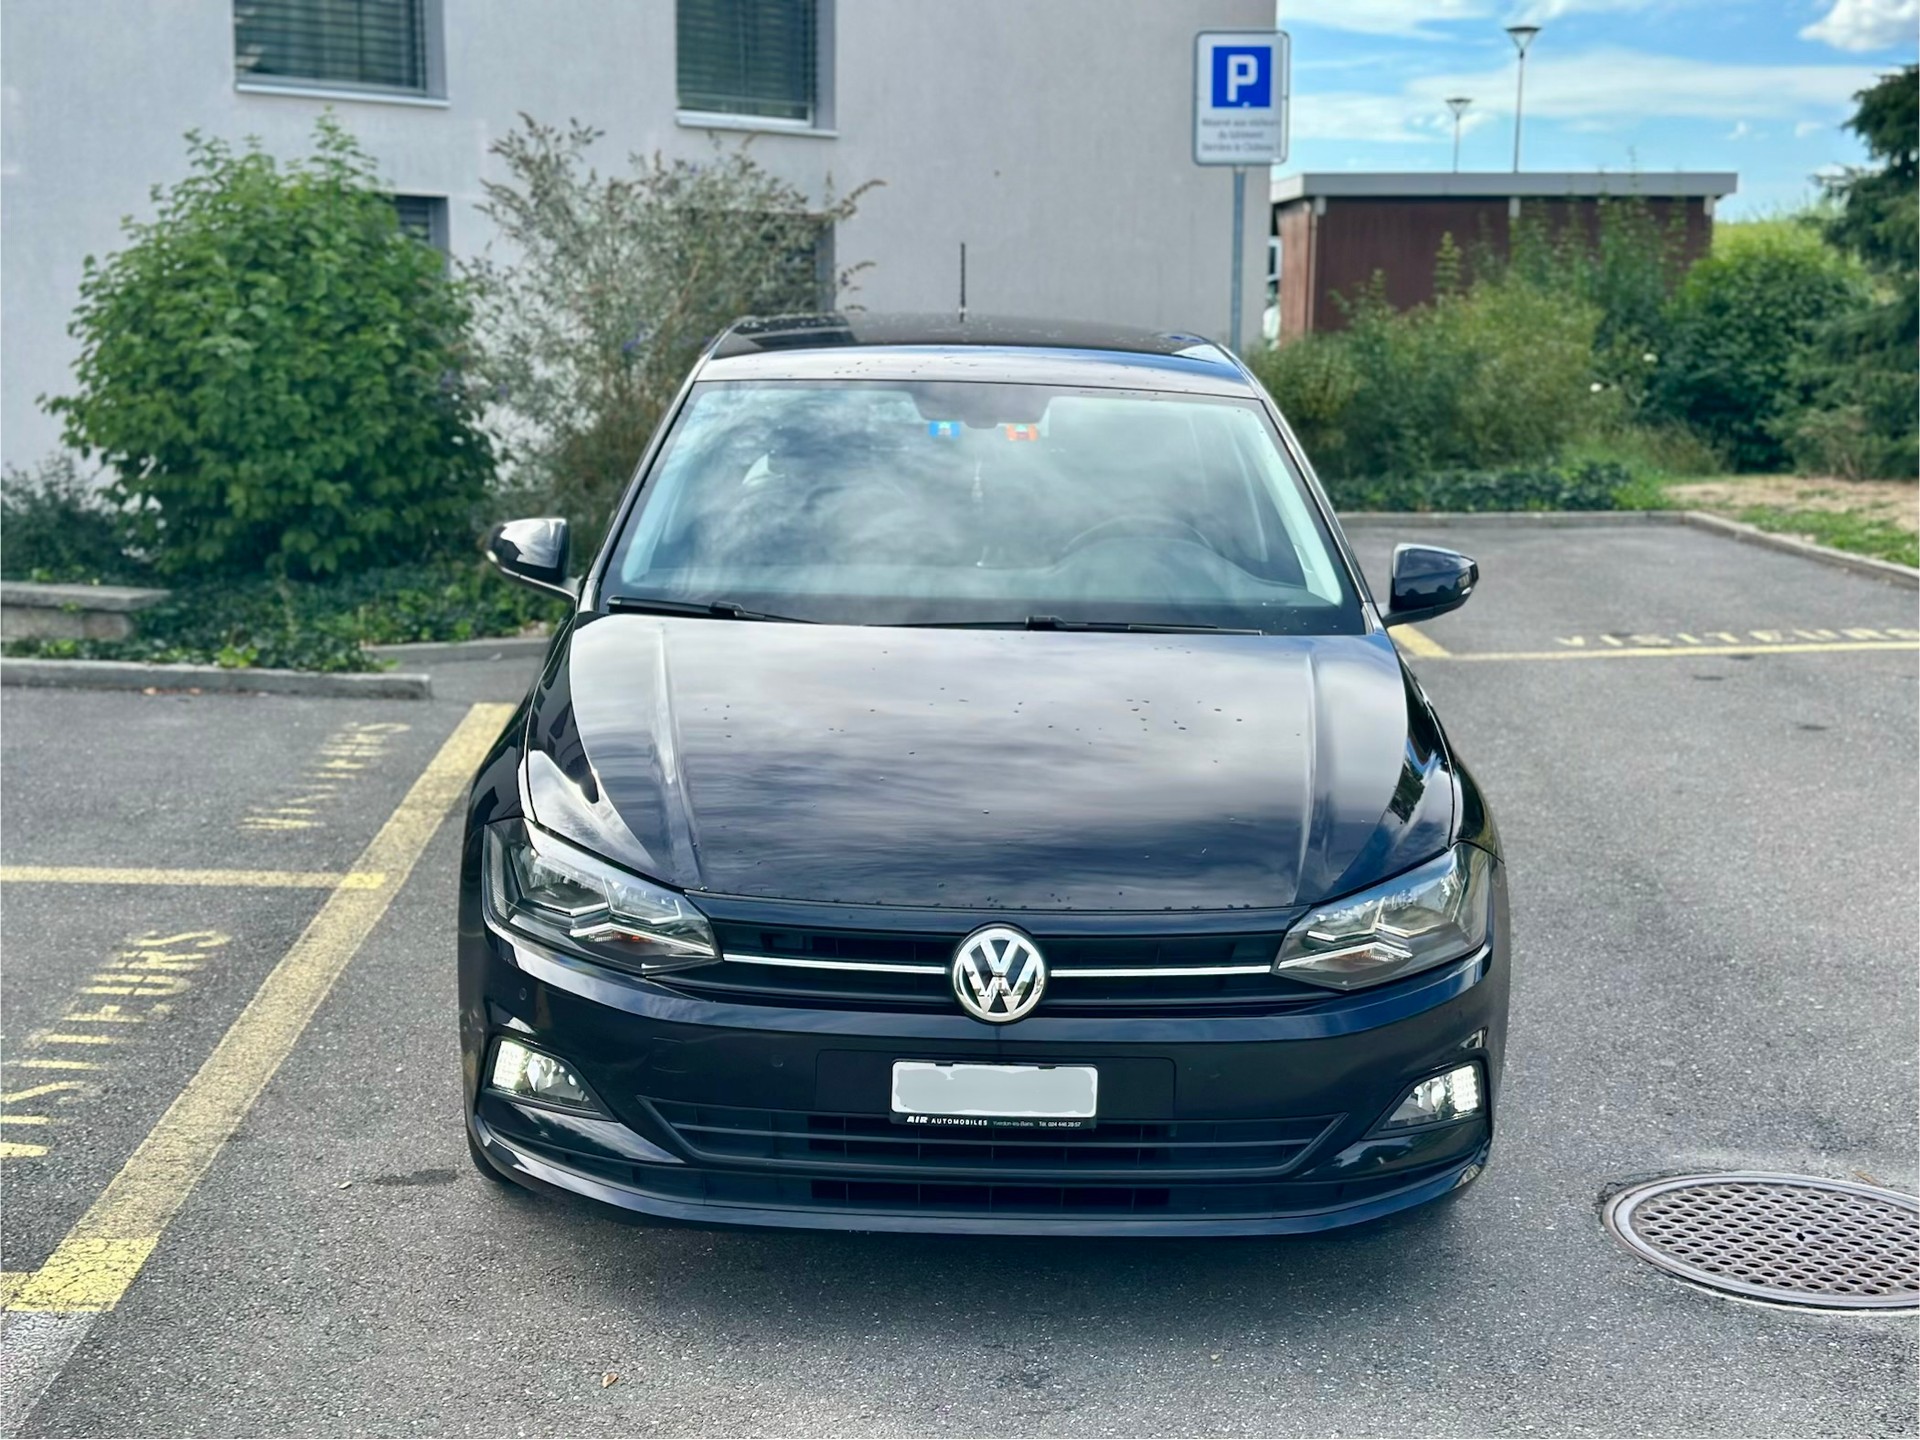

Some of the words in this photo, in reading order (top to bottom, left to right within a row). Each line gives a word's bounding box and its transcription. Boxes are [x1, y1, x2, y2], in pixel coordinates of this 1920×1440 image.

[1227, 54, 1258, 102] P
[954, 929, 1044, 1022] VW
[906, 1115, 928, 1124] AIR
[931, 1117, 988, 1126] AUTOMOBILES
